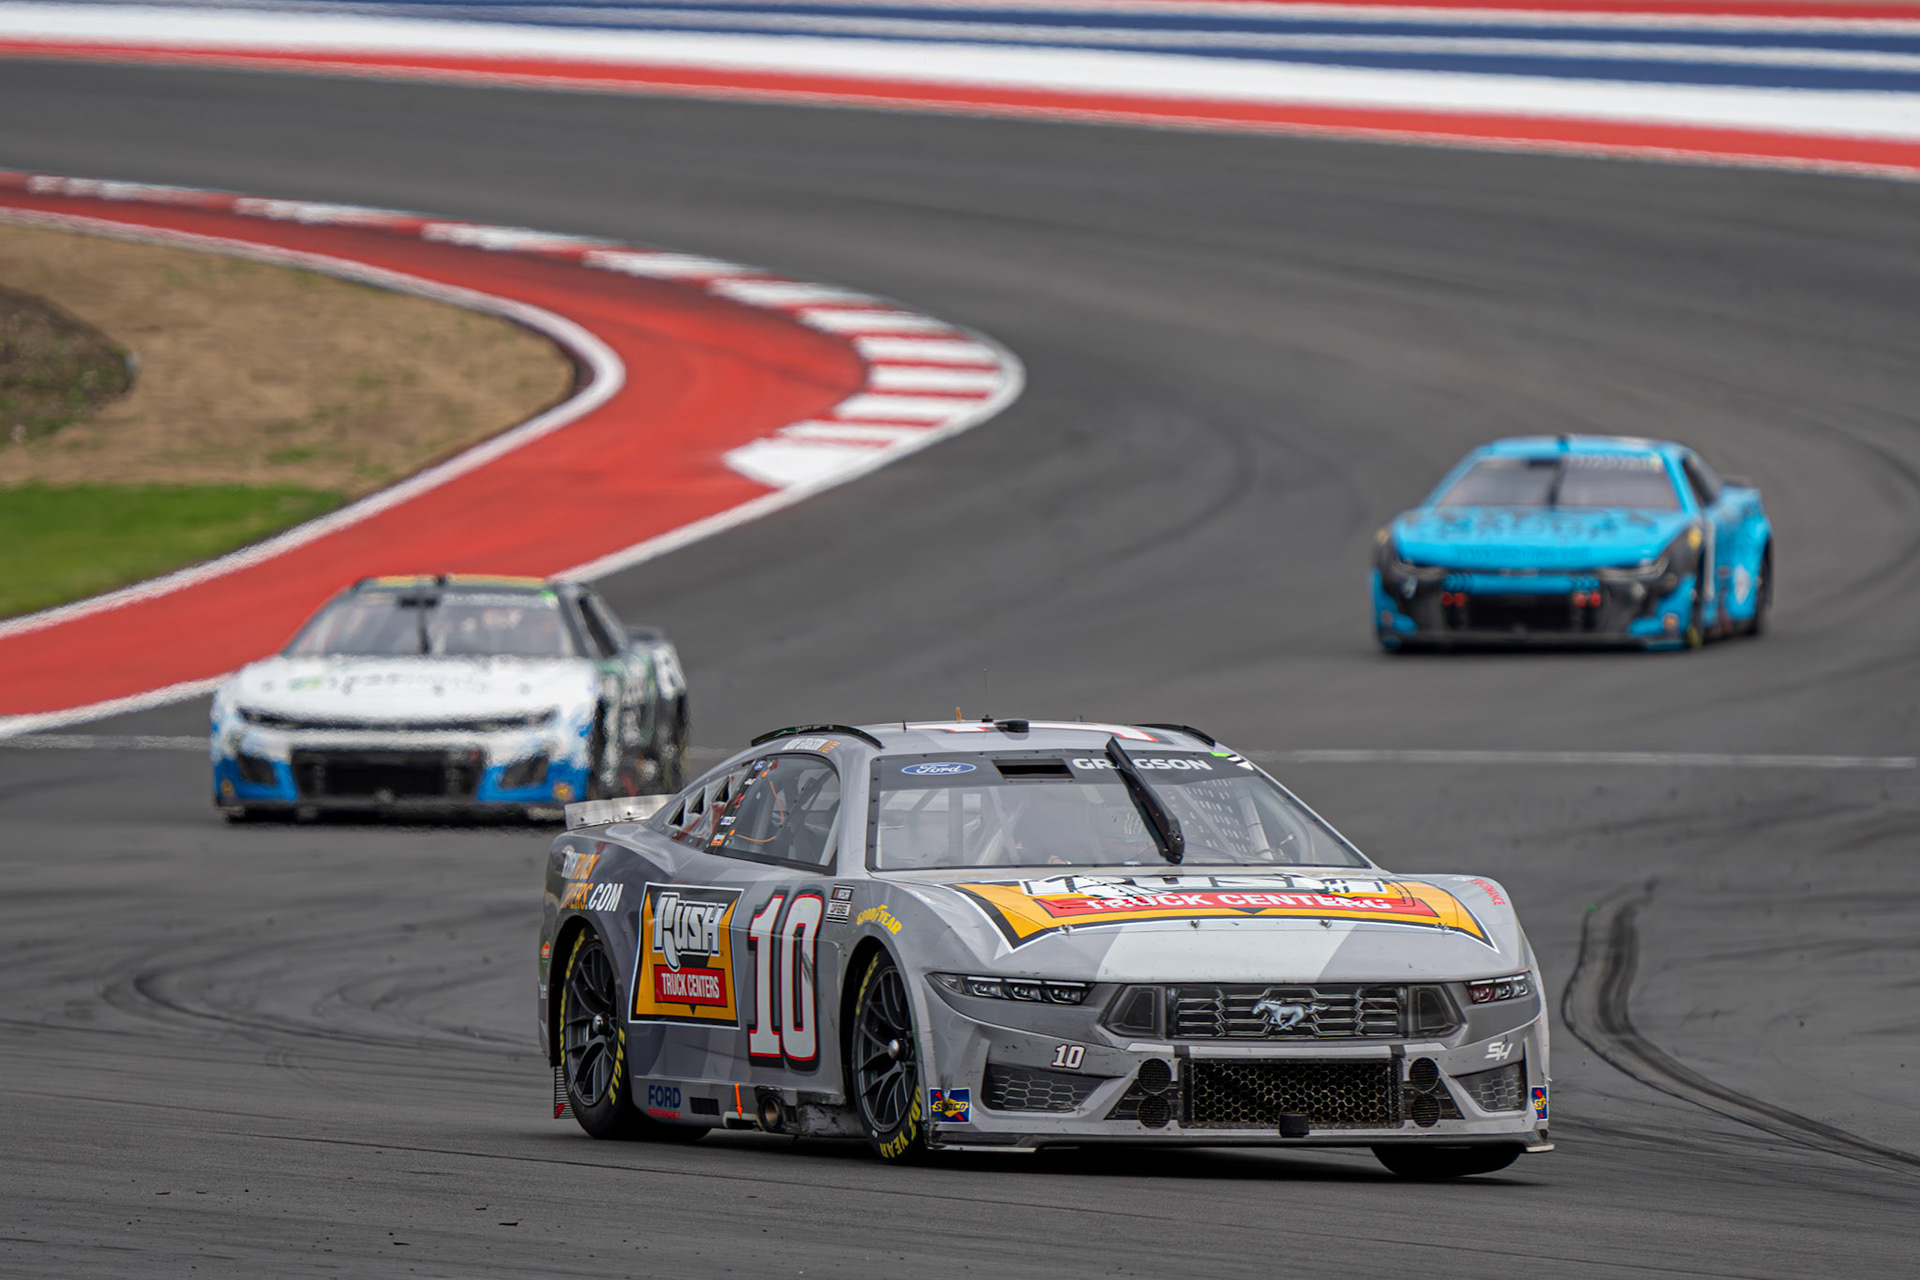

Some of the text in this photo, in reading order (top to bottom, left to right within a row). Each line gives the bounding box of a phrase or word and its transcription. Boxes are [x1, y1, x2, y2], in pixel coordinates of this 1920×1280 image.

[1072, 757, 1213, 771] GRGSON
[661, 972, 721, 999] TRUCK CENTERS
[749, 892, 824, 1062] 10
[608, 1026, 626, 1106] EAGLE
[1051, 1043, 1086, 1069] 10
[648, 1084, 682, 1109] FORD
